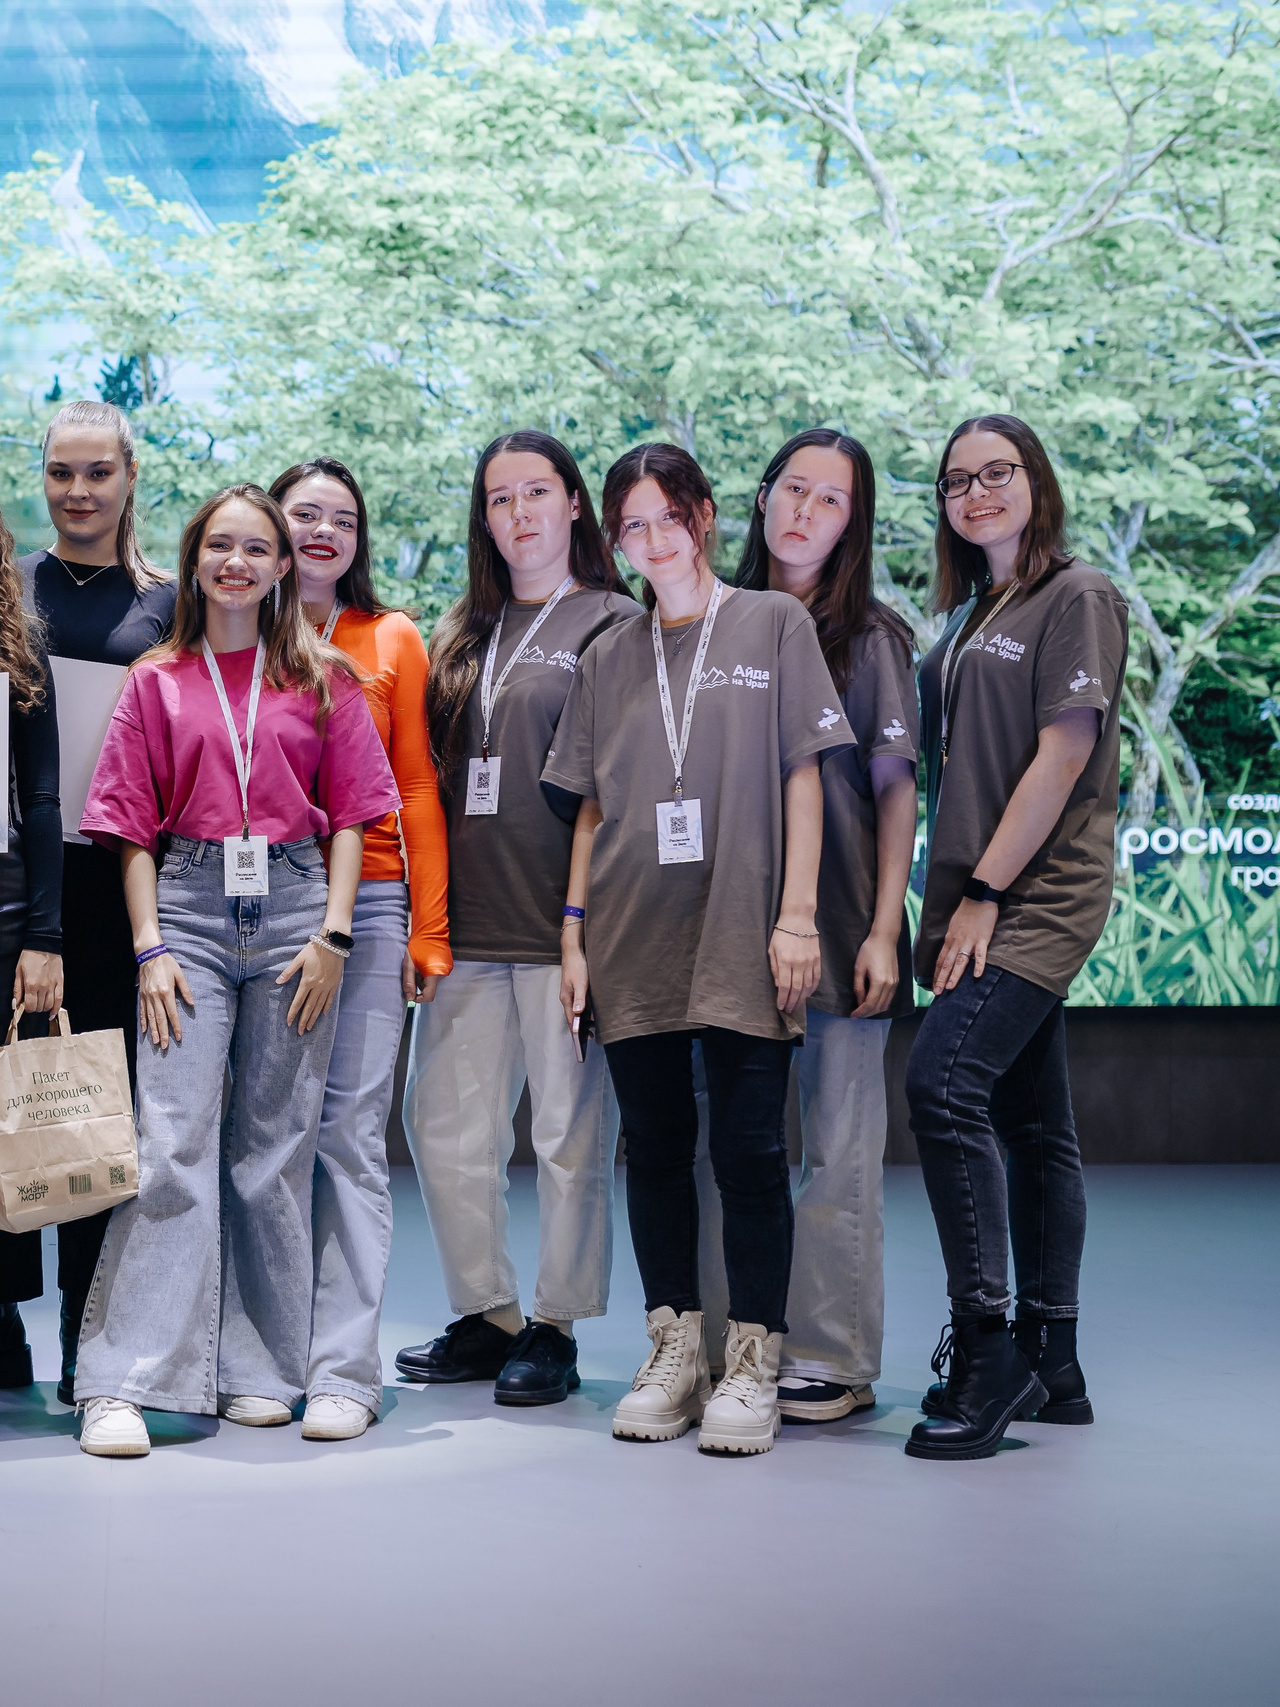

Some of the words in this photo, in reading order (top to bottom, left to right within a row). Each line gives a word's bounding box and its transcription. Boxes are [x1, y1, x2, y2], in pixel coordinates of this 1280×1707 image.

[989, 633, 1025, 654] Айда
[550, 650, 577, 665] Айд
[984, 645, 996, 653] на
[998, 647, 1021, 662] Урал
[559, 660, 575, 673] Ура
[732, 664, 770, 680] Айда
[746, 678, 769, 689] Урал
[1227, 794, 1280, 813] созд
[32, 1071, 70, 1085] Пакет
[6, 1093, 33, 1110] для
[36, 1084, 103, 1105] хорошего
[28, 1103, 91, 1121] человека
[17, 1182, 49, 1195] Жизнь
[21, 1191, 46, 1203] март
